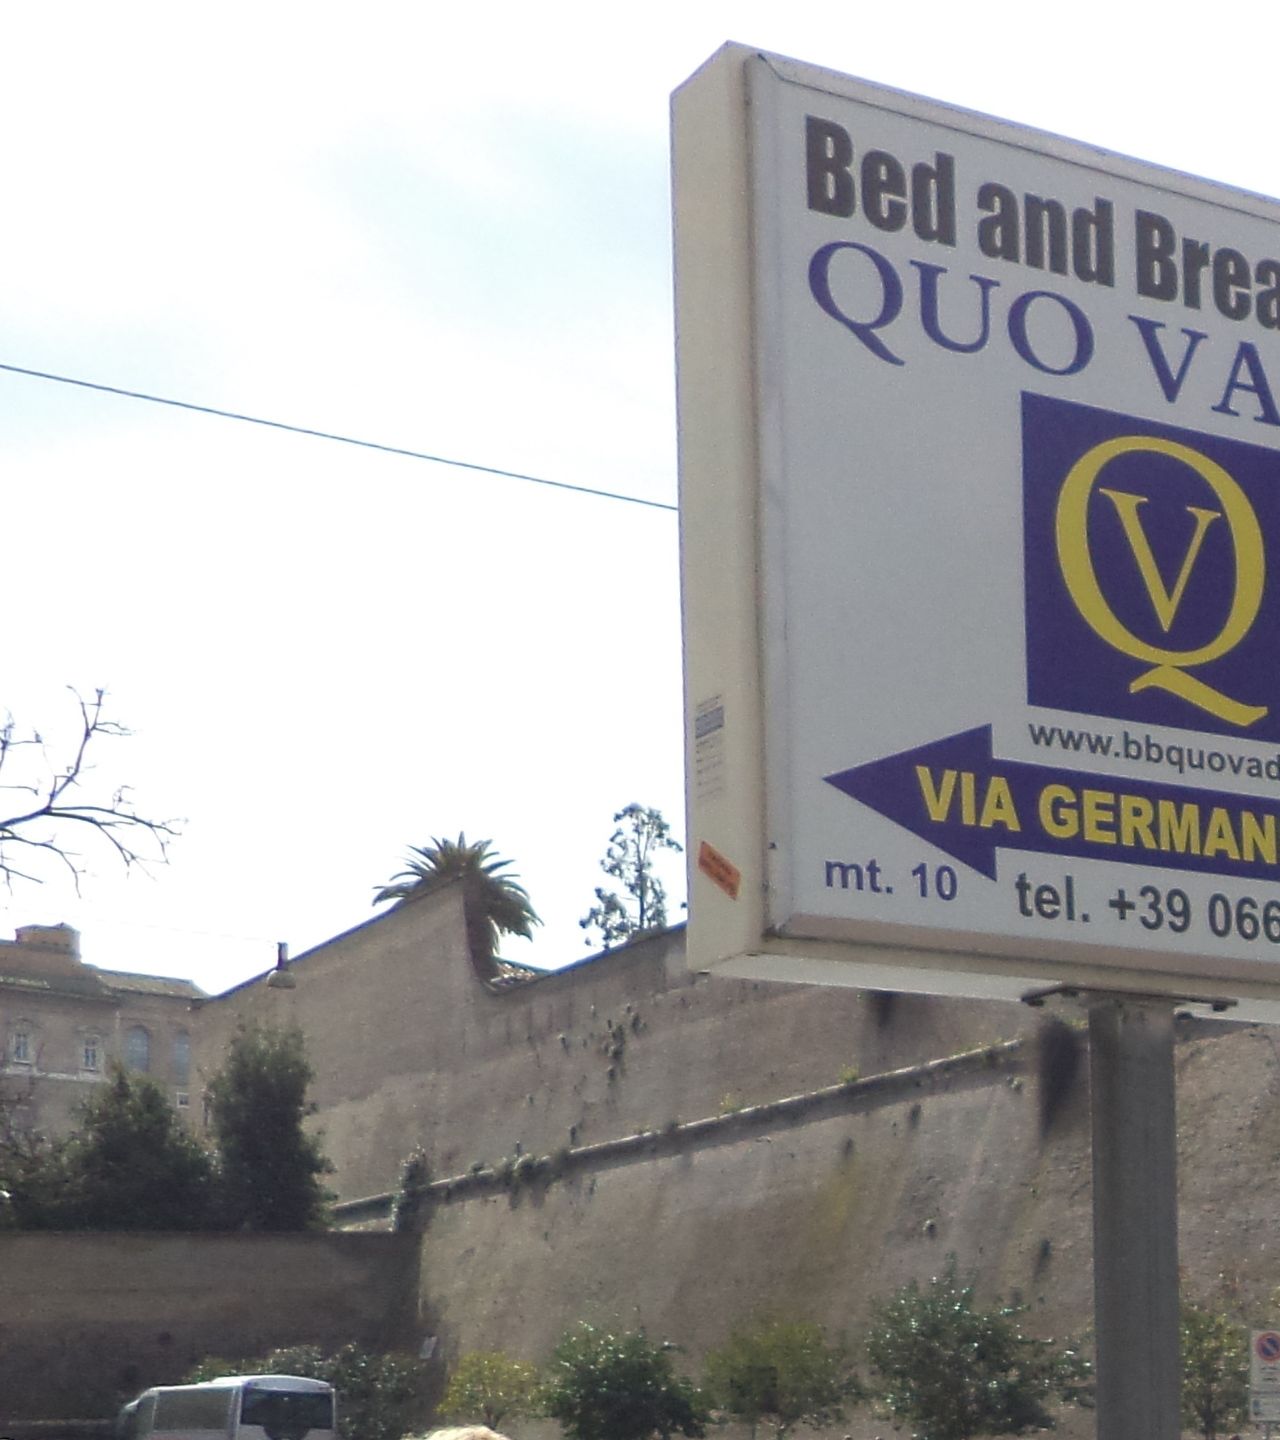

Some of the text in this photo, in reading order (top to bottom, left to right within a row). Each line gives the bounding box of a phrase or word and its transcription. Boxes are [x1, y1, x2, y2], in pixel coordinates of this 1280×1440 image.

[804, 114, 957, 249] Bed
[977, 178, 1116, 289] and
[808, 240, 1096, 377] QUO
[915, 764, 1022, 832] VIA
[825, 859, 959, 901] mt. 10
[1015, 871, 1091, 924] tel.
[1109, 884, 1193, 934] +39
